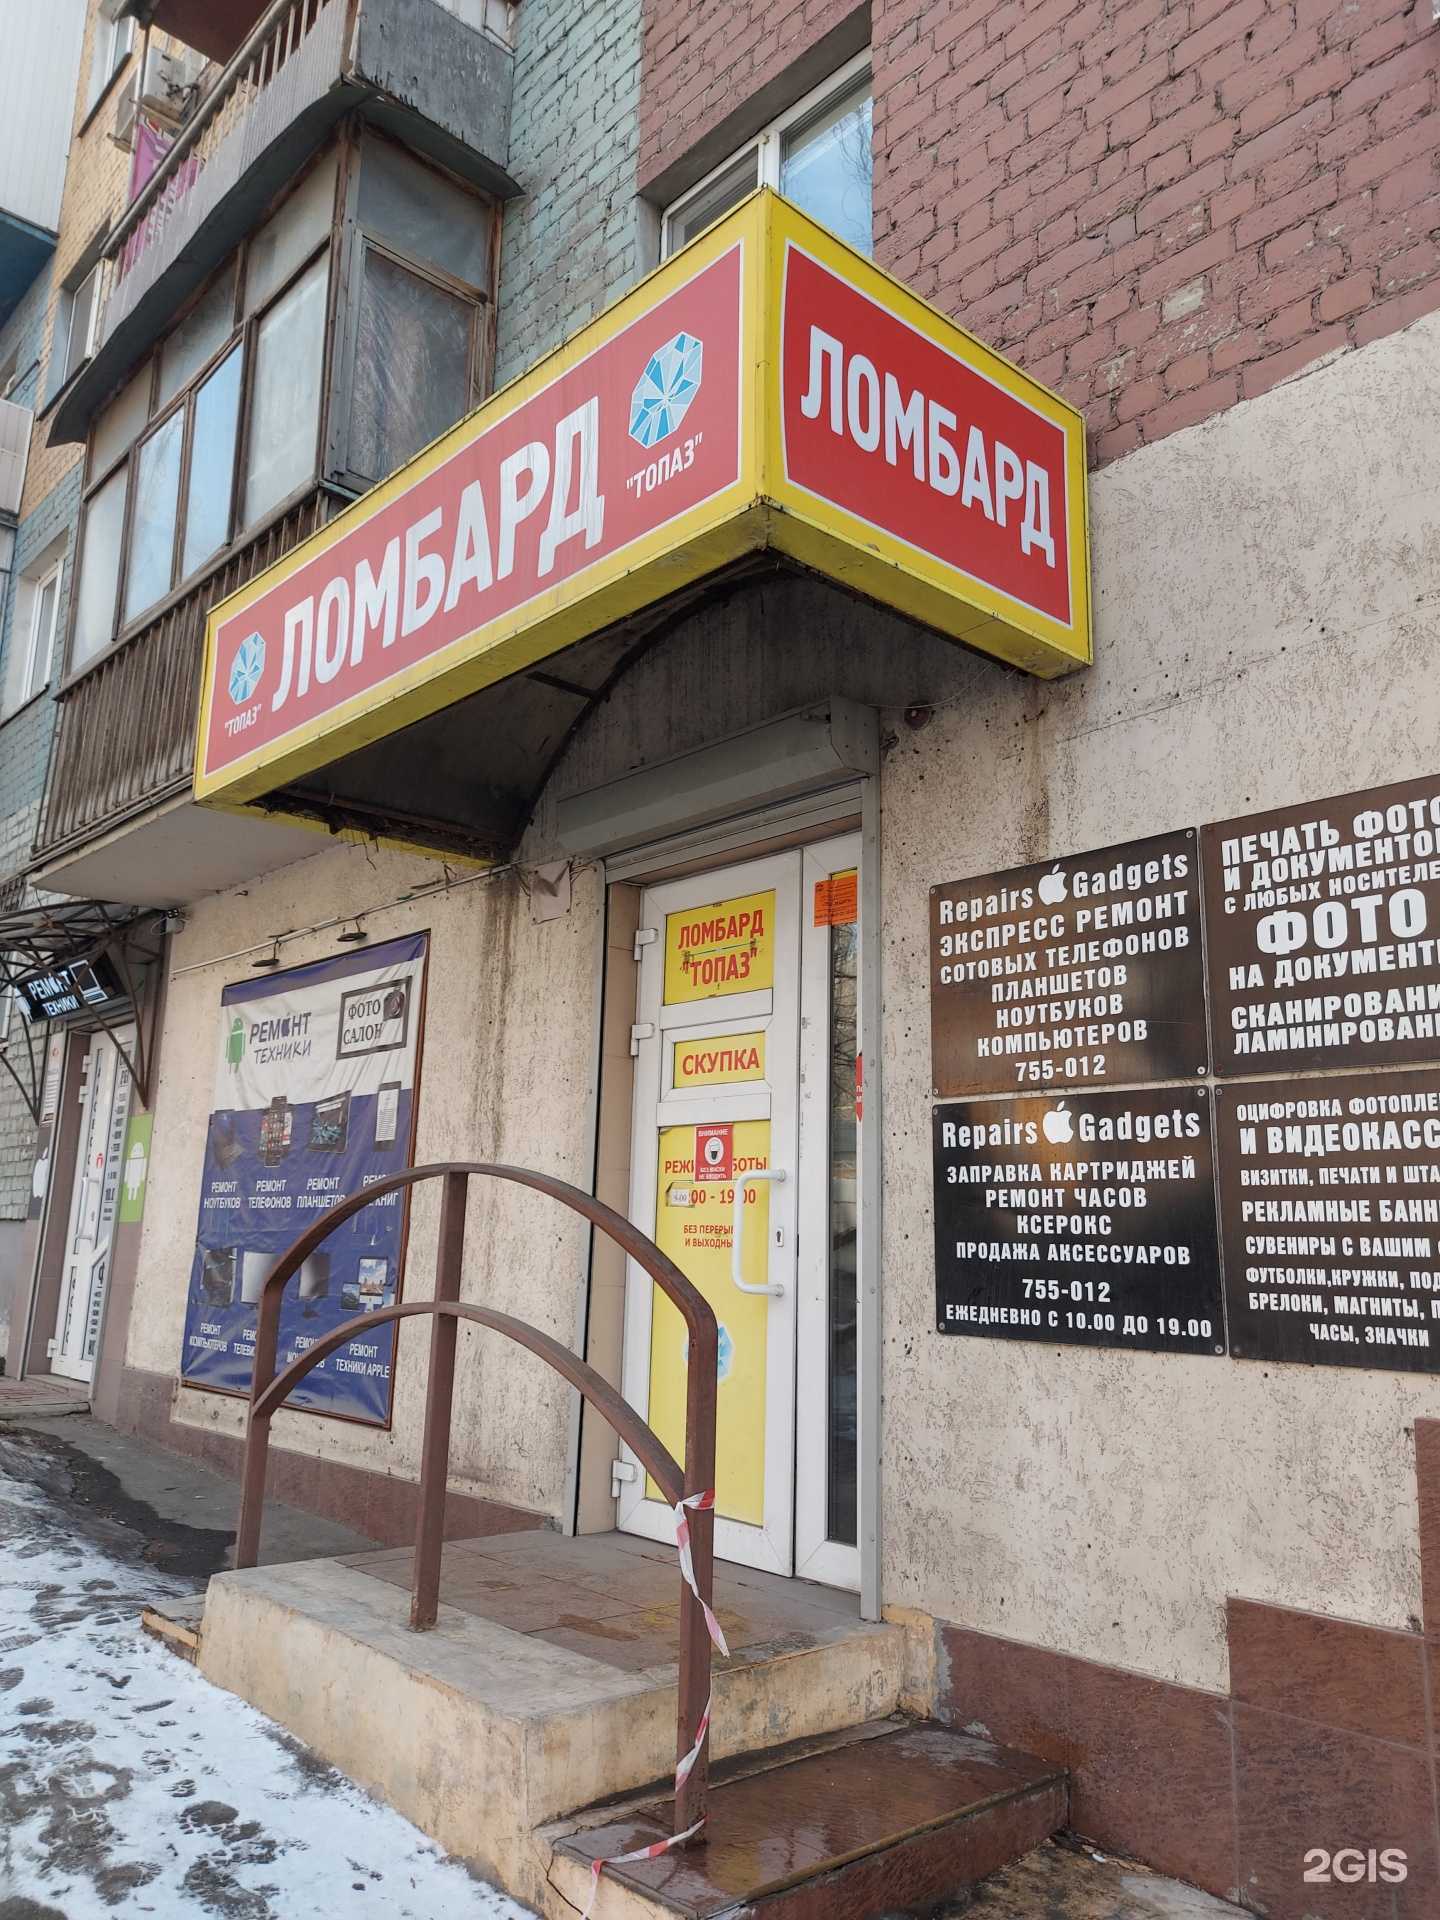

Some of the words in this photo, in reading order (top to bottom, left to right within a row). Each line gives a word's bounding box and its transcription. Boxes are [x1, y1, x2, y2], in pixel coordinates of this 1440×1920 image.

[802, 325, 1057, 568] ЛОМБАРД
[626, 432, 703, 498] "ТОПАЗ"
[272, 396, 604, 712] ЛОМБАРД
[225, 704, 262, 737] "ТОПАЗ"
[1222, 819, 1340, 866] ПЕЧАТЬ
[1224, 866, 1241, 893] И
[1251, 828, 1440, 890] ДОКУМЕНТО
[939, 888, 1033, 924] Repairs
[1073, 854, 1188, 898] Gadgets
[1243, 881, 1321, 911] ЛЮБЫХ
[678, 909, 764, 950] ЛОМБАРД
[940, 914, 1065, 957] ЭКСПРЕСС
[1076, 890, 1188, 933] РЕМОНТ
[1256, 888, 1427, 956] ФОТО
[940, 951, 1037, 984] СОТОВЫХ
[1046, 926, 1189, 968] ТЕЛЕФОНОВ
[1229, 964, 1264, 991] НА
[1274, 939, 1440, 988] ДОКУМЕНТ
[991, 965, 1127, 1003] ПЛАНШЕТОВ
[348, 999, 381, 1020] ФОТО
[997, 993, 1123, 1028] НОУТБУКОВ
[343, 1022, 383, 1045] САЛОН
[977, 1019, 1147, 1057] КОМПЬЮТЕРОВ
[254, 1040, 312, 1065] ТЕХНИКИ
[682, 1047, 760, 1075] СКУПКА
[1015, 1054, 1106, 1081] 755-012
[1236, 1099, 1342, 1123] ОЦИФРОВКА
[1349, 1093, 1440, 1115] ФОТОПЛЕ
[942, 1119, 1037, 1149] Repairs
[1079, 1109, 1200, 1143] Gadgets
[1240, 1127, 1257, 1154] И
[1267, 1118, 1440, 1157] ВИДЕОКАСС
[947, 1164, 1042, 1183] ЗАПРАВКА
[1050, 1155, 1196, 1183] КАРТРИДЖЕЙ
[1240, 1169, 1314, 1187] ВИЗИТКИ,
[1319, 1167, 1380, 1185] ПЕЧАТИ
[1386, 1167, 1397, 1184] И
[211, 1181, 238, 1193] РЕМОНТ
[256, 1179, 287, 1192] РЕМОНТ
[307, 1176, 340, 1191] РЕМОНТ
[986, 1189, 1065, 1208] РЕМОНТ
[1074, 1187, 1147, 1208] ЧАСОВ
[248, 1196, 292, 1209] ТЕЛЕФОНОВ
[1242, 1200, 1372, 1223] РЕКЛАМНЫЕ
[1379, 1199, 1440, 1223] БАНН
[683, 1224, 697, 1234] БЕЗ
[699, 1224, 733, 1235] ПЕРЕРЫ
[1017, 1215, 1112, 1235] КСЕРОКС
[685, 1238, 691, 1247] И
[956, 1242, 1040, 1262] ПРОДАЖА
[1047, 1243, 1190, 1265] АКСЕССУАРОВ
[1245, 1236, 1335, 1256] СУВЕНИРЫ
[1342, 1237, 1353, 1256] С
[1360, 1237, 1431, 1258] ВАШИМ
[1022, 1279, 1111, 1303] 755-012
[1248, 1292, 1328, 1316] БРЕЛОКИ,
[1334, 1295, 1425, 1320] МАГНИТЫ,
[946, 1304, 1041, 1326] ЕЖЕДНЕВНО
[1048, 1311, 1058, 1327] С
[1066, 1312, 1115, 1331] 10.00
[1123, 1315, 1148, 1335] ДО
[1156, 1317, 1212, 1338] 19.00
[1310, 1323, 1359, 1344] ЧАСЫ,
[1365, 1326, 1430, 1347] ЗНАЧКИ
[349, 1344, 378, 1359] РЕМОНТ
[336, 1358, 367, 1375] ТЕХНИКИ
[367, 1362, 390, 1379] APPLE
